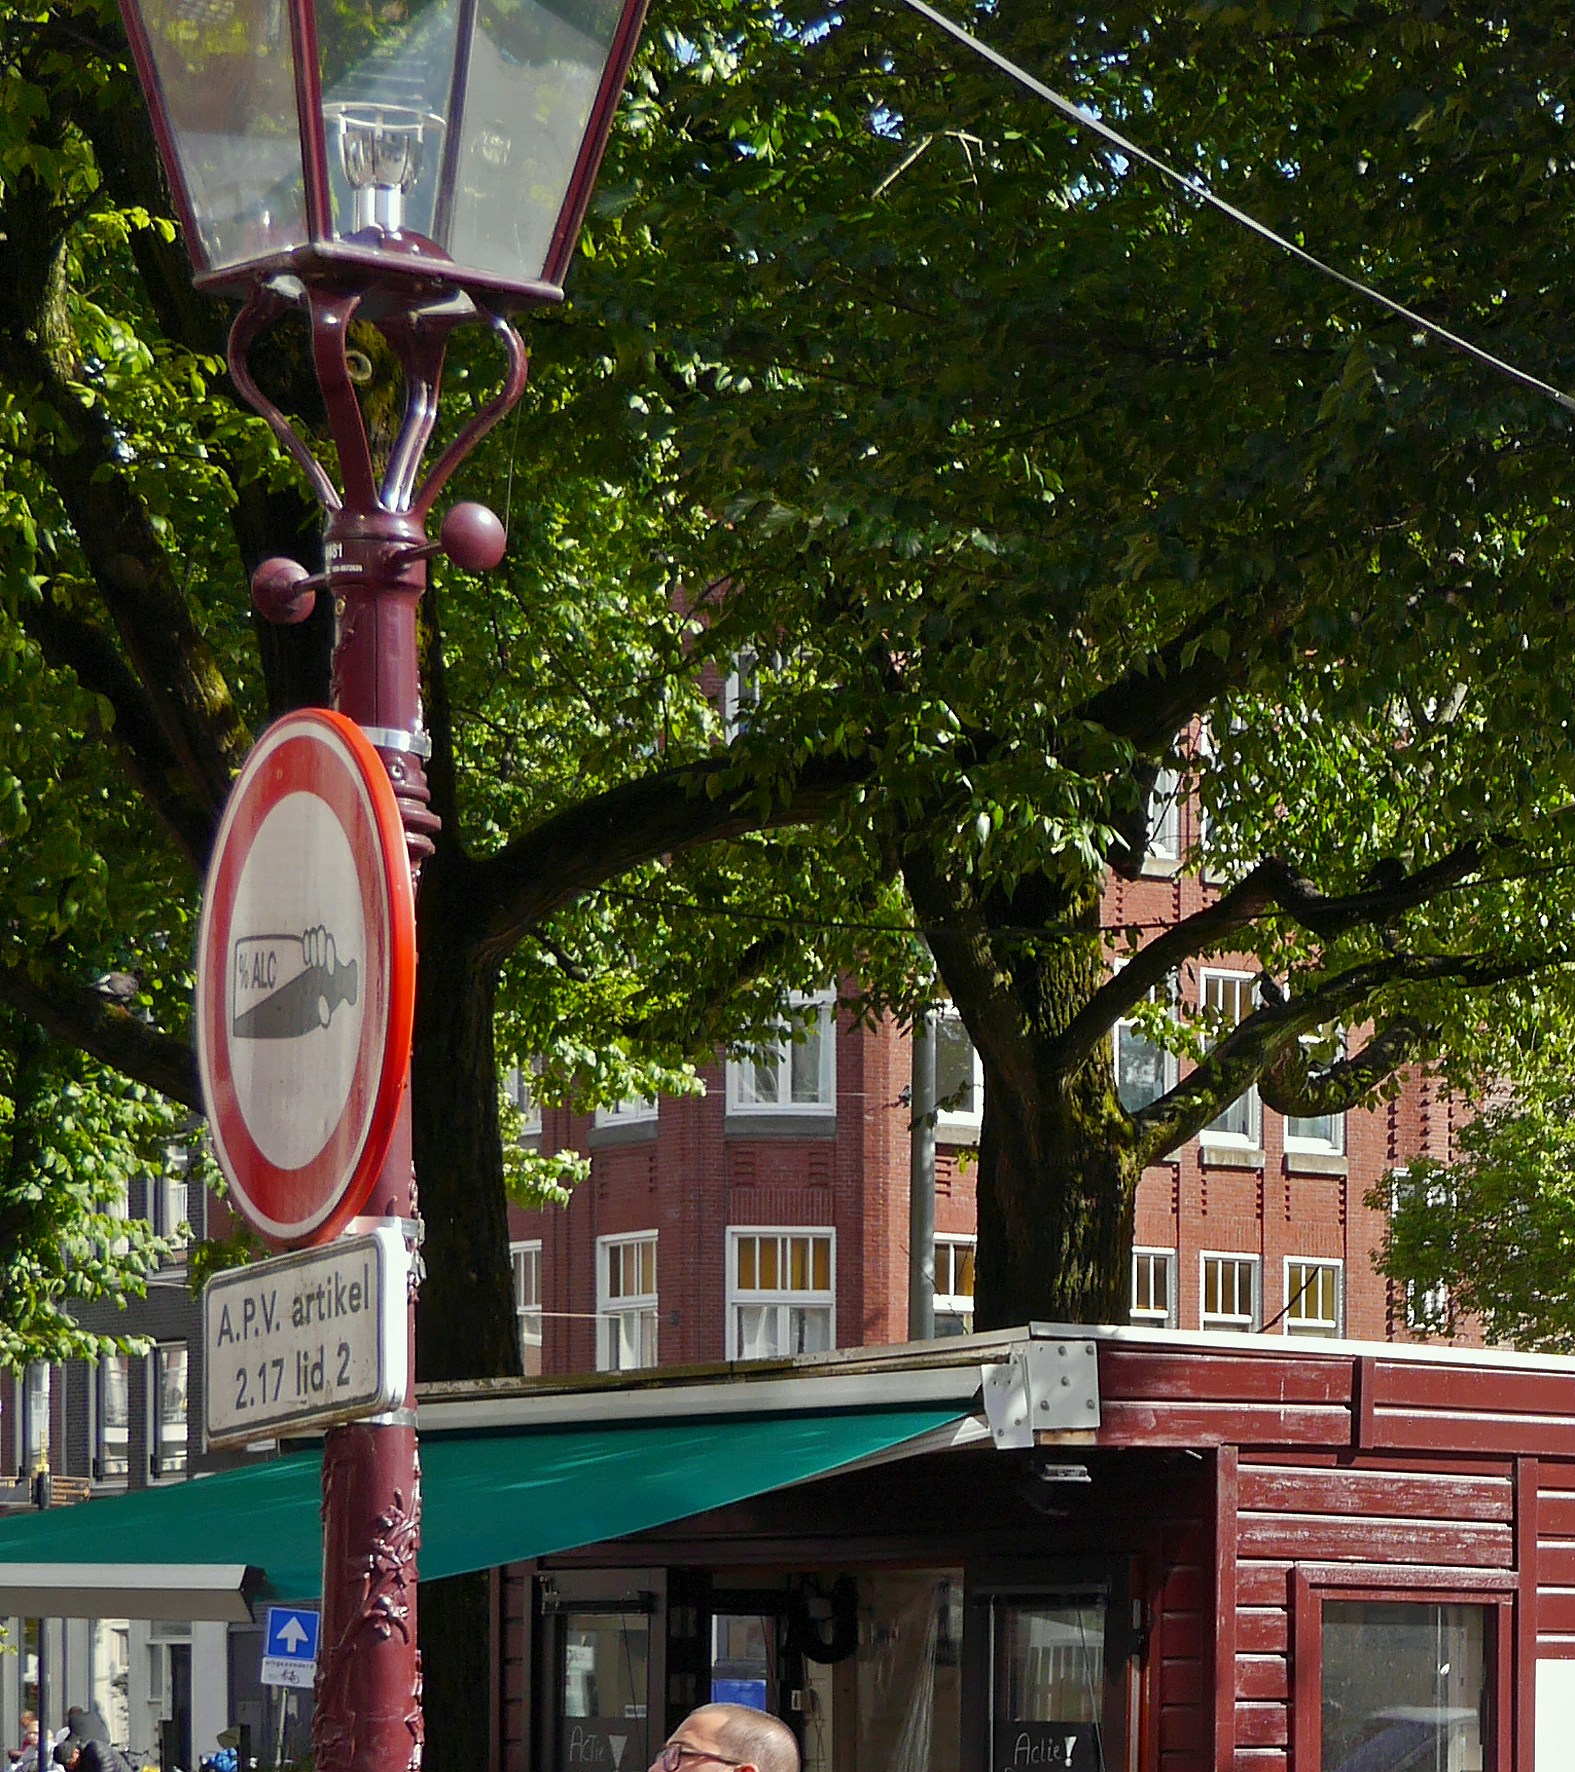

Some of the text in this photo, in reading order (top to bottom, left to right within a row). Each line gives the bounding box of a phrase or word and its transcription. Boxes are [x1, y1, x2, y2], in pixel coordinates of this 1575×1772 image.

[252, 951, 277, 989] ALC
[217, 1263, 370, 1347] A.P.V. artikel
[235, 1341, 351, 1410] 2.17 lid 2
